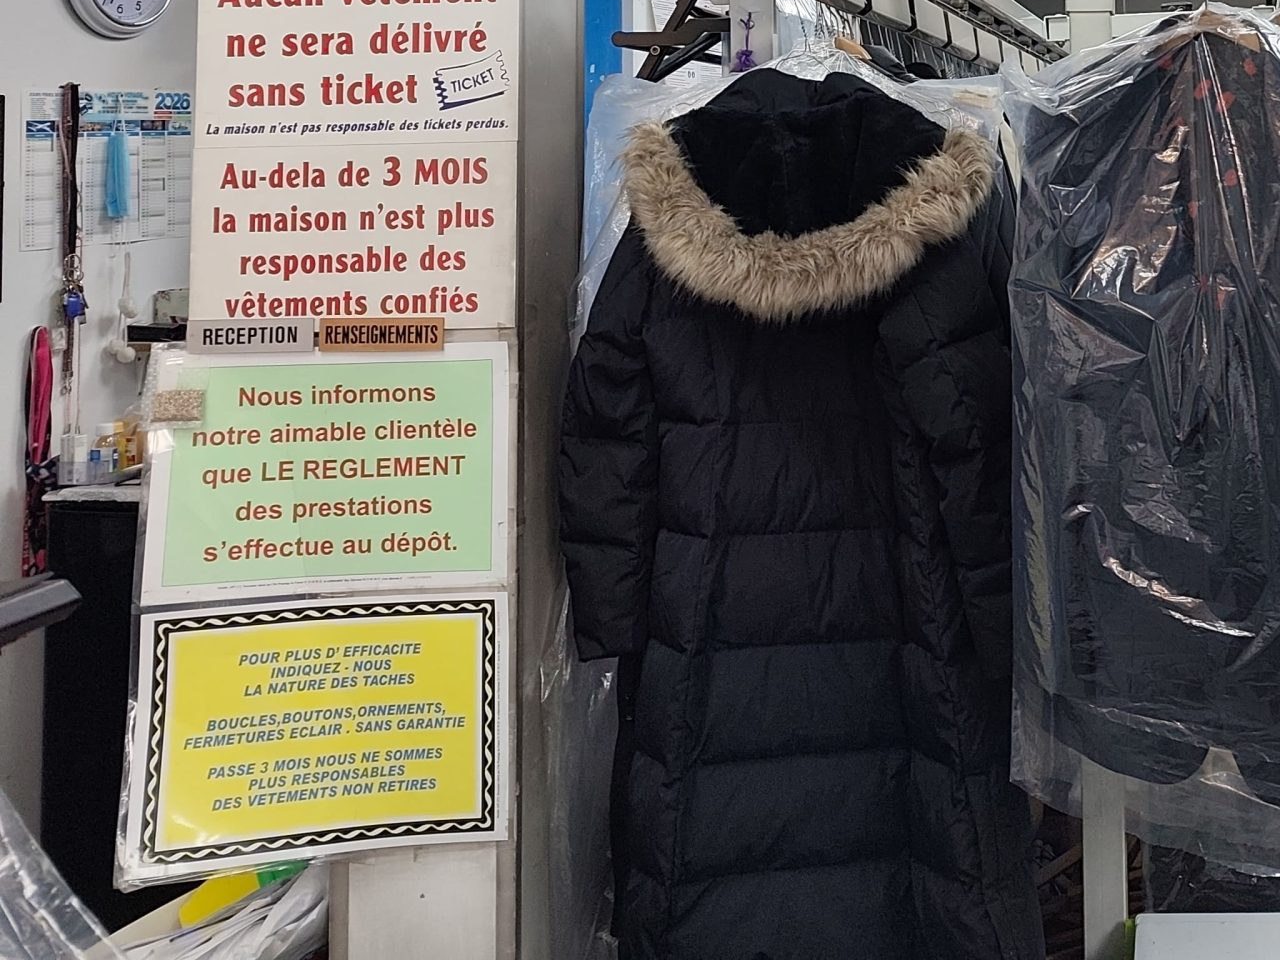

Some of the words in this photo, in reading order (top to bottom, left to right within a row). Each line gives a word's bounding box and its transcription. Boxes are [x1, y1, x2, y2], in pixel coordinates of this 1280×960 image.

[226, 33, 266, 57] ne
[281, 31, 354, 57] sera
[369, 20, 487, 54] délivré
[228, 81, 305, 107] sans
[320, 73, 418, 106] ticket
[450, 67, 495, 93] TICKET
[154, 92, 190, 110] 2026
[205, 123, 220, 135] La
[223, 121, 265, 135] maison
[301, 122, 322, 135] pas
[325, 119, 395, 134] responsable
[399, 119, 419, 131] des
[423, 118, 462, 130] tickets
[465, 117, 509, 131] perdus.
[220, 160, 325, 190] Au-dela
[338, 160, 370, 188] de
[382, 156, 401, 186] 3
[414, 157, 489, 185] MOIS
[212, 207, 236, 234] la
[249, 205, 347, 233] maison
[437, 201, 495, 235] plus
[240, 245, 407, 282] responsable
[419, 244, 466, 272] des
[225, 290, 367, 318] vêtements
[380, 286, 479, 315] confiés
[202, 325, 298, 345] RECEPTION
[324, 325, 438, 345] RENSEIGNEMENTS
[238, 387, 303, 407] Nous
[311, 384, 436, 405] informons
[191, 425, 261, 447] notre
[270, 421, 366, 444] aimable
[374, 418, 477, 440] clientèle
[201, 464, 252, 490] que
[261, 461, 295, 482] LE
[303, 455, 466, 481] REGLEMENT
[235, 500, 283, 522] des
[291, 495, 433, 523] prestations
[342, 537, 372, 555] au
[380, 532, 458, 559] dépôt.
[238, 651, 280, 666] POUR
[284, 648, 321, 663] PLUS
[342, 642, 422, 658] EFFICACITE
[270, 662, 341, 680] INDIQUEZ
[352, 659, 392, 673] NOUS
[244, 683, 263, 697] LA
[267, 679, 326, 695] NATURE
[330, 676, 358, 689] DES
[362, 673, 415, 687] TACHES
[183, 728, 285, 750] FERMETURES
[289, 723, 342, 740] ECLAIR
[355, 719, 393, 733] SANS
[396, 715, 466, 731] GARANTIE
[207, 763, 256, 780] PASSE
[259, 762, 269, 774] 3
[273, 757, 311, 773] MOIS
[315, 754, 356, 769] NOUS
[360, 751, 380, 764] NE
[384, 747, 443, 762] SOMMES
[247, 775, 287, 791] PLUS
[291, 764, 406, 786] RESPONSABLES
[212, 795, 242, 811] DES
[247, 786, 338, 808] VETEMENTS
[341, 783, 373, 797] NON
[377, 778, 437, 793] RETIRES
